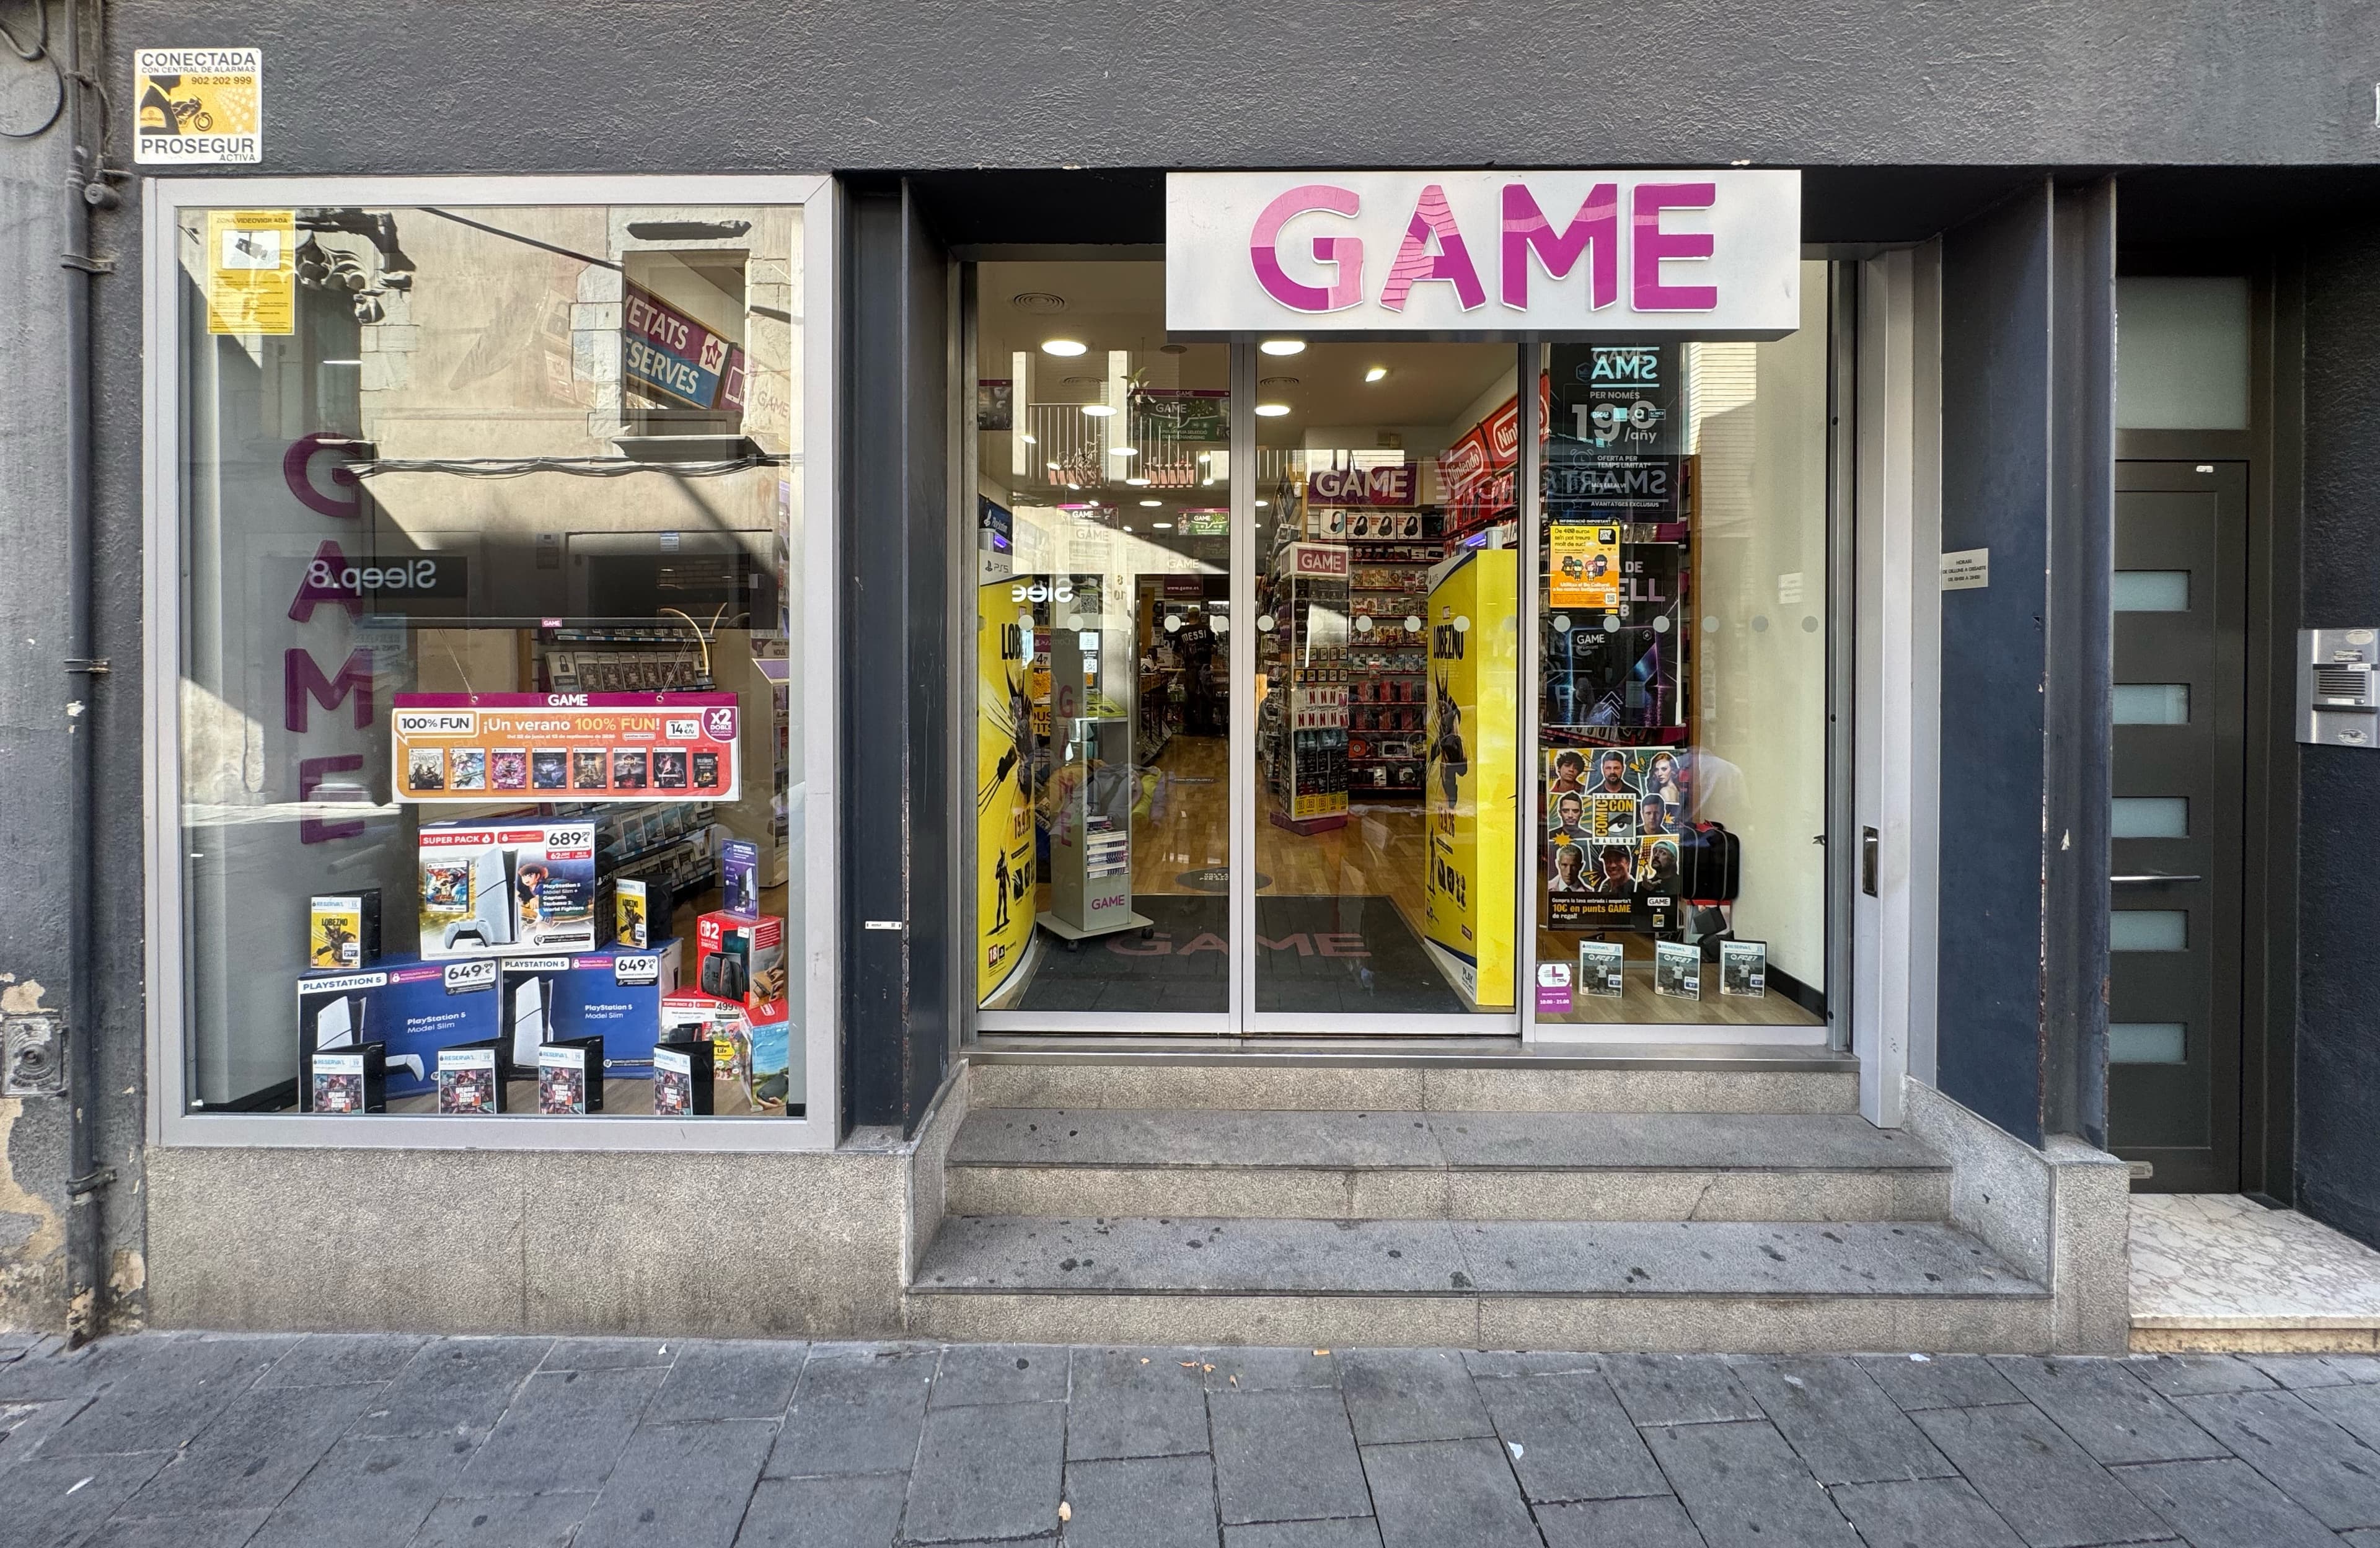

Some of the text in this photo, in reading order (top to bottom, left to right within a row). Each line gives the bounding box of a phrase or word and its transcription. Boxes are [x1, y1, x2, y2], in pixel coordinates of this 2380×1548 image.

[141, 52, 256, 66] CONECTADA
[192, 76, 252, 84] 902 202 999
[141, 138, 254, 154] PROSEGUR
[219, 153, 256, 162] ACTIVA
[1249, 182, 1718, 314] GAME
[625, 337, 699, 395] SERVES
[1590, 390, 1641, 399] PER NOMÉS
[757, 390, 789, 418] GAME
[1155, 403, 1187, 413] GAME
[1448, 451, 1480, 483] Nintendo
[1316, 470, 1408, 498] GAME
[1076, 528, 1110, 542] GAME
[994, 563, 1009, 573] PS5
[1167, 559, 1199, 569] GAME
[1302, 553, 1342, 571] GAME
[1624, 561, 1644, 573] DE
[543, 619, 561, 627] GAME
[283, 431, 373, 845] GAME
[1181, 629, 1207, 643] MESSI
[1577, 634, 1605, 644] GAME
[547, 694, 588, 706] GAME
[402, 717, 469, 729] 100% FUN
[710, 708, 732, 725] x2
[483, 717, 661, 734] ¡Un verano 100% FUN!
[671, 724, 683, 734] 14
[1608, 799, 1633, 812] CON
[1595, 799, 1608, 837] COMIC
[423, 835, 480, 845] SUPER PACK
[549, 832, 581, 846] 689
[1091, 894, 1126, 911] GAME
[1552, 904, 1568, 913] 10€
[1582, 904, 1606, 914] punts
[1608, 904, 1632, 913] GAME
[734, 906, 747, 914] GAME
[321, 918, 348, 926] LOBEZNO
[710, 923, 720, 939] 2
[1106, 933, 1372, 957] GAME
[989, 948, 997, 963] 18
[448, 963, 482, 980] 649
[619, 959, 646, 971] 649
[302, 978, 374, 992] PLAYSTATION
[407, 1013, 459, 1026] PlayStation
[407, 1024, 435, 1034] Model
